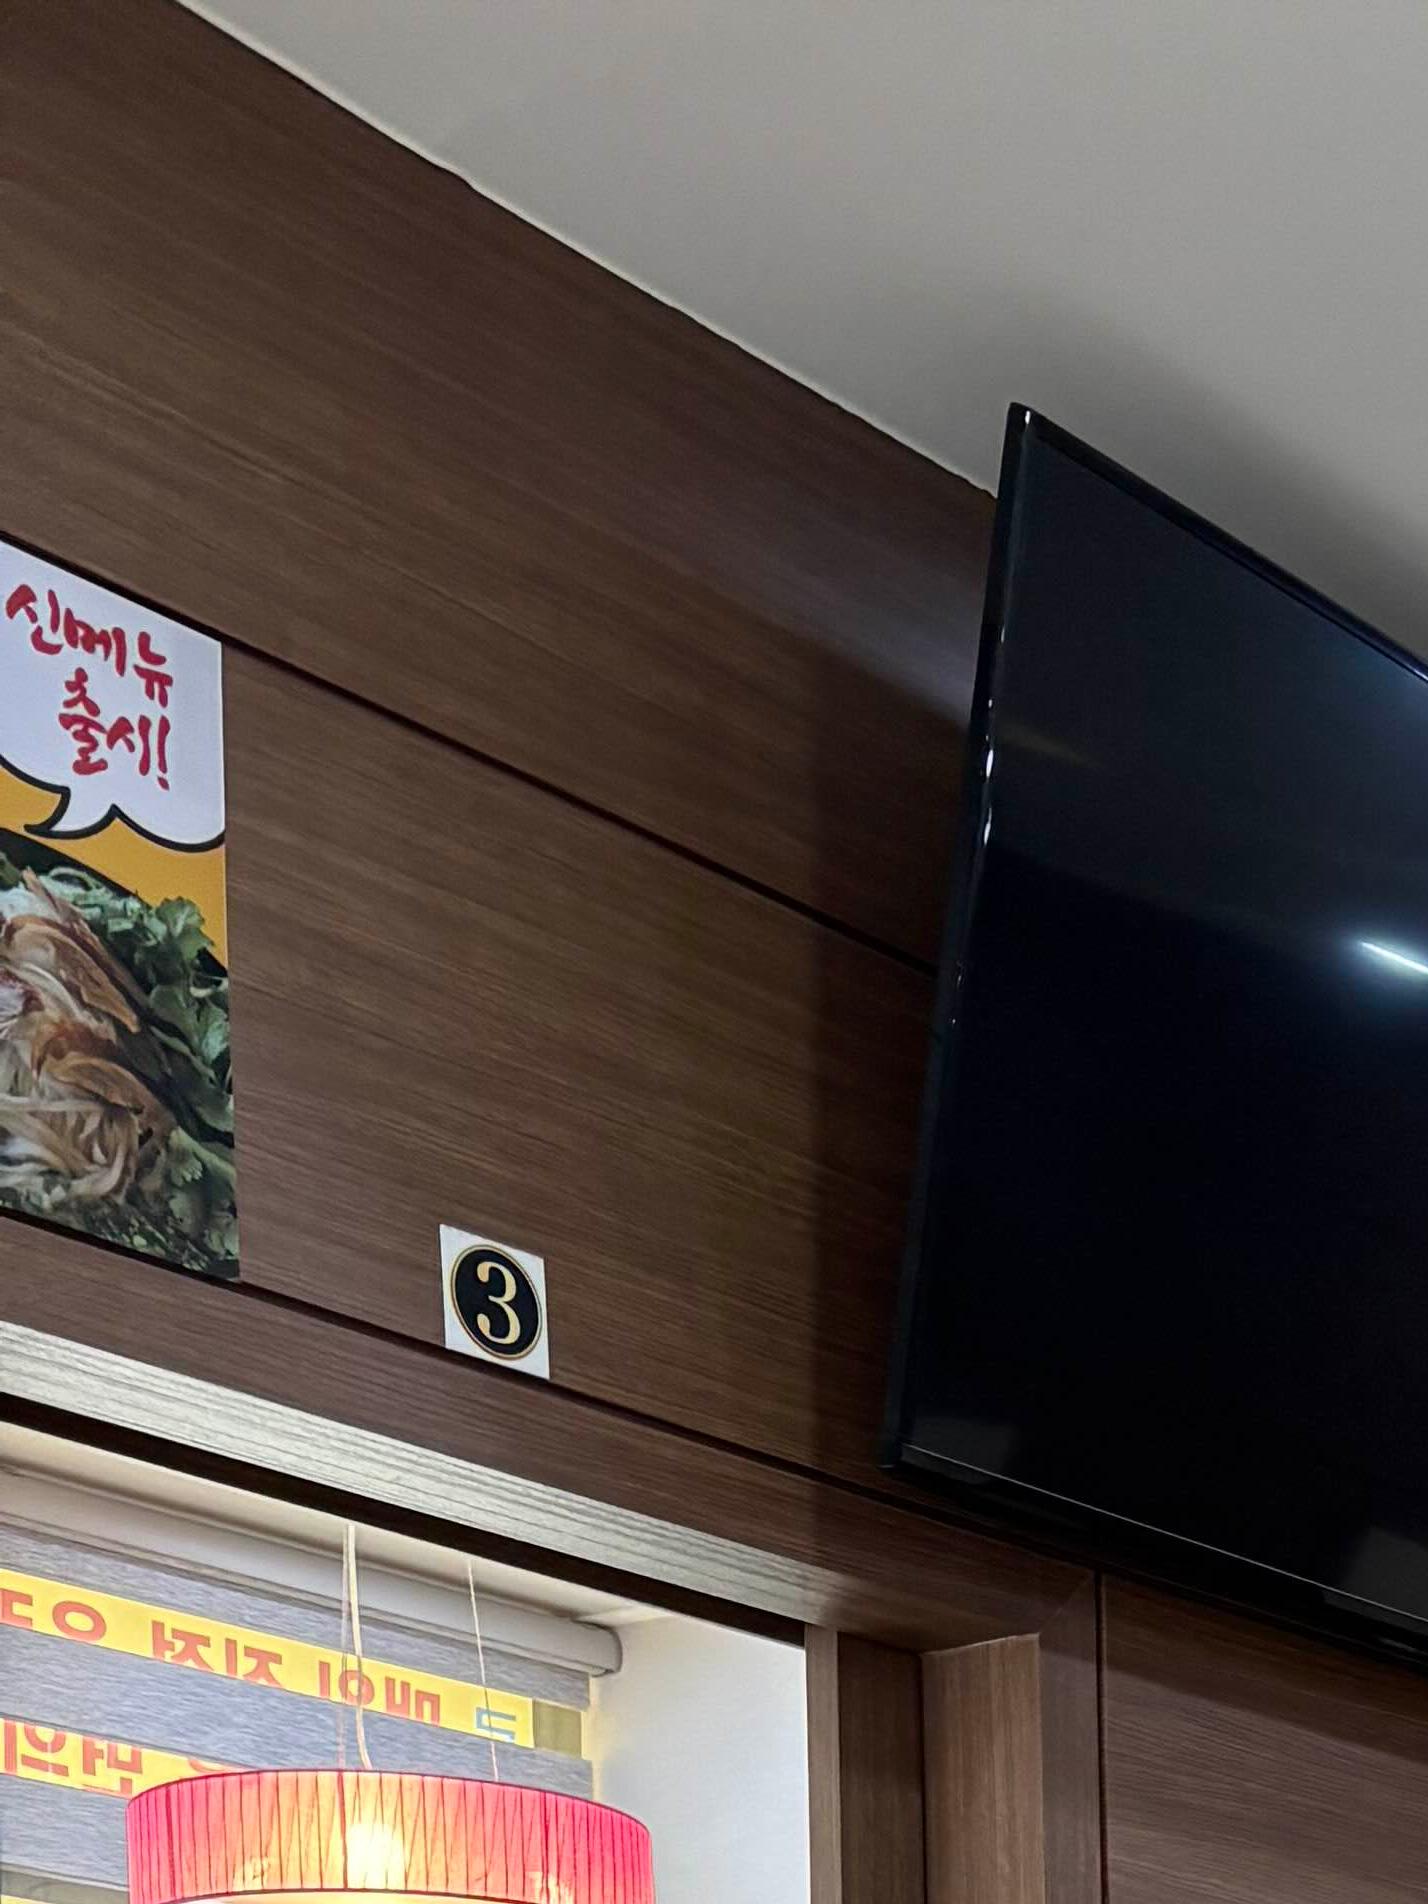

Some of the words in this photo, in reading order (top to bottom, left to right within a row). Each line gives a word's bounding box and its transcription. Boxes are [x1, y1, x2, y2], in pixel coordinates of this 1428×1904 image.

[5, 584, 173, 709] 신메뉴
[58, 666, 171, 792] 출시!
[476, 1261, 521, 1344] 3
